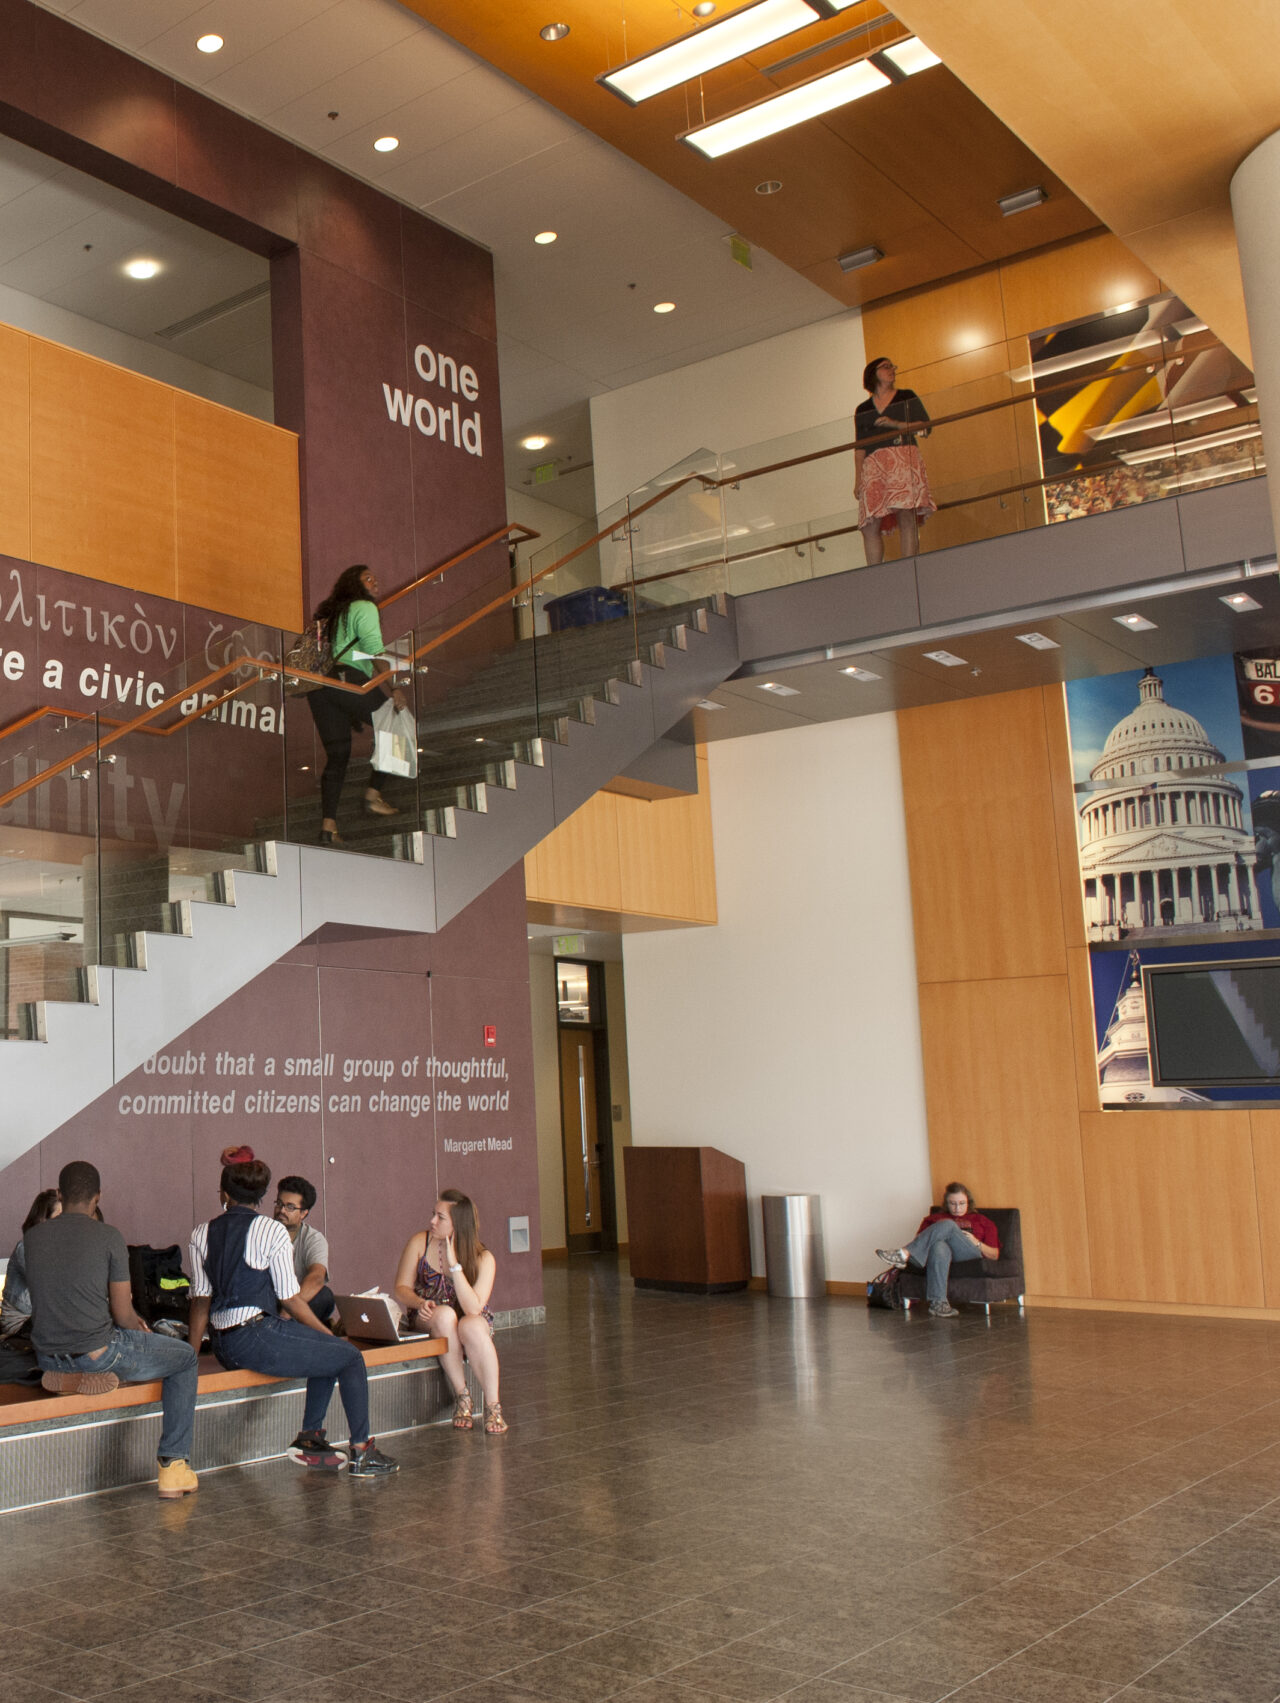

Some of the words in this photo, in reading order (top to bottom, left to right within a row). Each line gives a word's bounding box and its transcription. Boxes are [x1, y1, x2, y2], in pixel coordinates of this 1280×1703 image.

[414, 344, 479, 402] one
[382, 382, 483, 457] world
[42, 659, 64, 690] a
[79, 663, 165, 709] civic
[143, 1050, 206, 1075] doubt
[215, 1051, 255, 1076] that
[264, 1057, 276, 1077] a
[283, 1053, 335, 1077] small
[343, 1057, 394, 1083] group
[401, 1055, 419, 1078] of
[426, 1056, 509, 1083] thoughtful,
[118, 1089, 236, 1115] committed
[244, 1089, 321, 1114] citizens
[328, 1093, 362, 1113] can
[368, 1090, 431, 1118] change
[436, 1090, 462, 1112] the
[468, 1090, 510, 1112] world
[444, 1137, 487, 1156] Margaret
[488, 1136, 513, 1151] Mead
